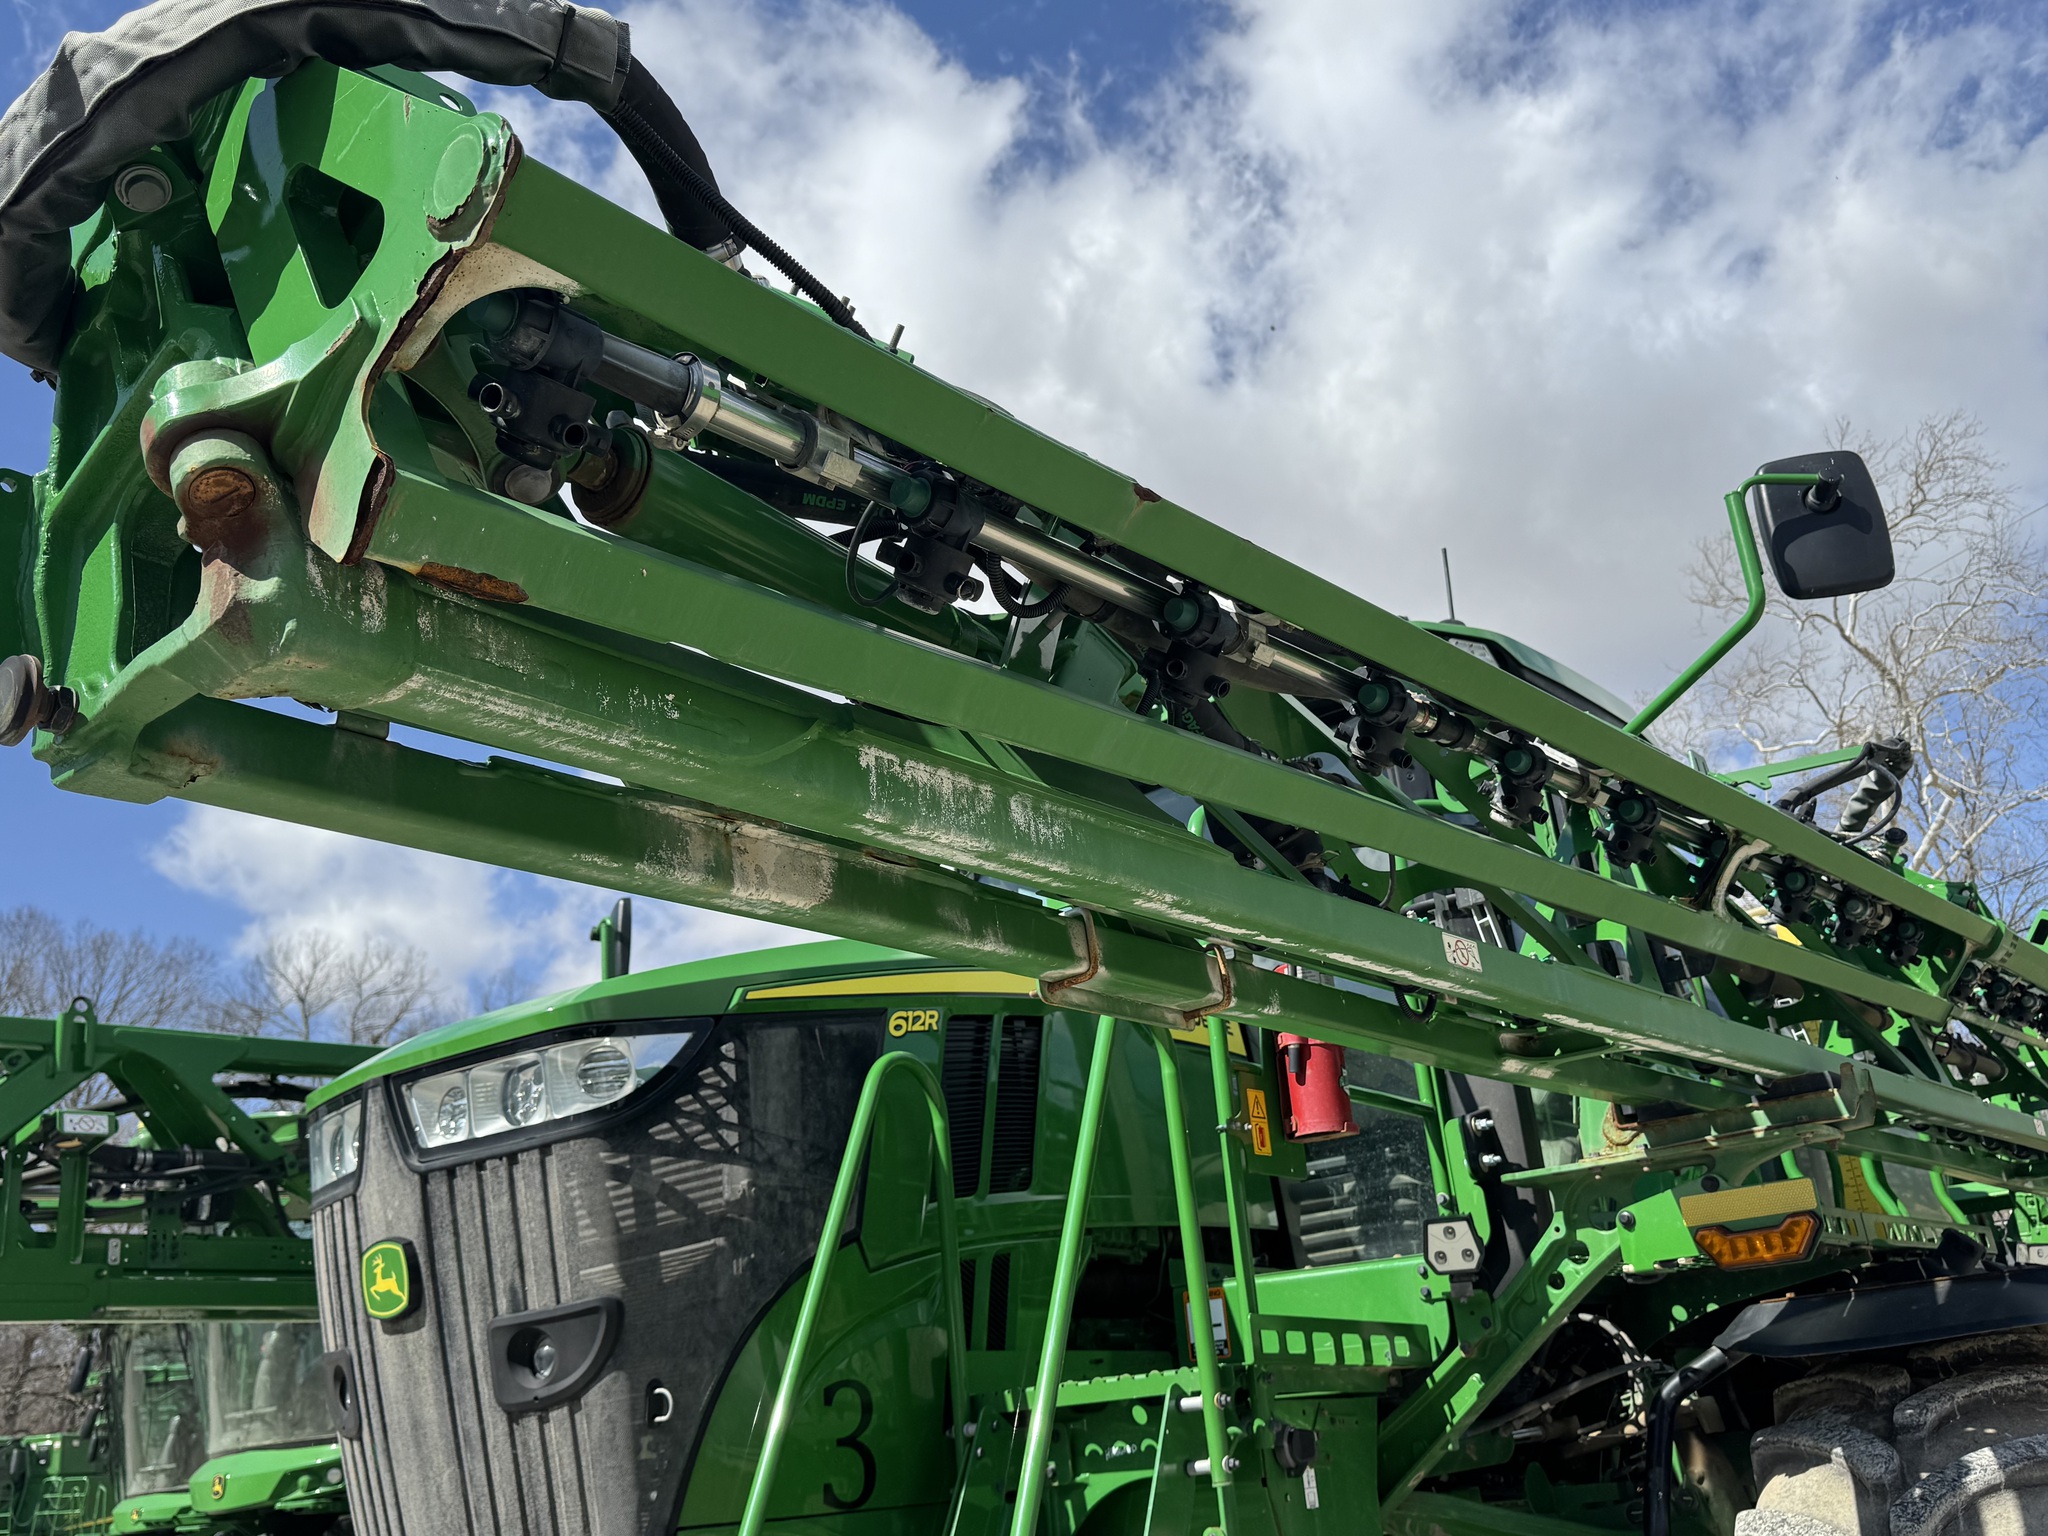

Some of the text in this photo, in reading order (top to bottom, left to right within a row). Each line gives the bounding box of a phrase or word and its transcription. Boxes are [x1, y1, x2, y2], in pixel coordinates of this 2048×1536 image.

[802, 493, 847, 511] EPDM
[888, 1009, 940, 1038] 612R
[823, 1379, 877, 1510] 3
